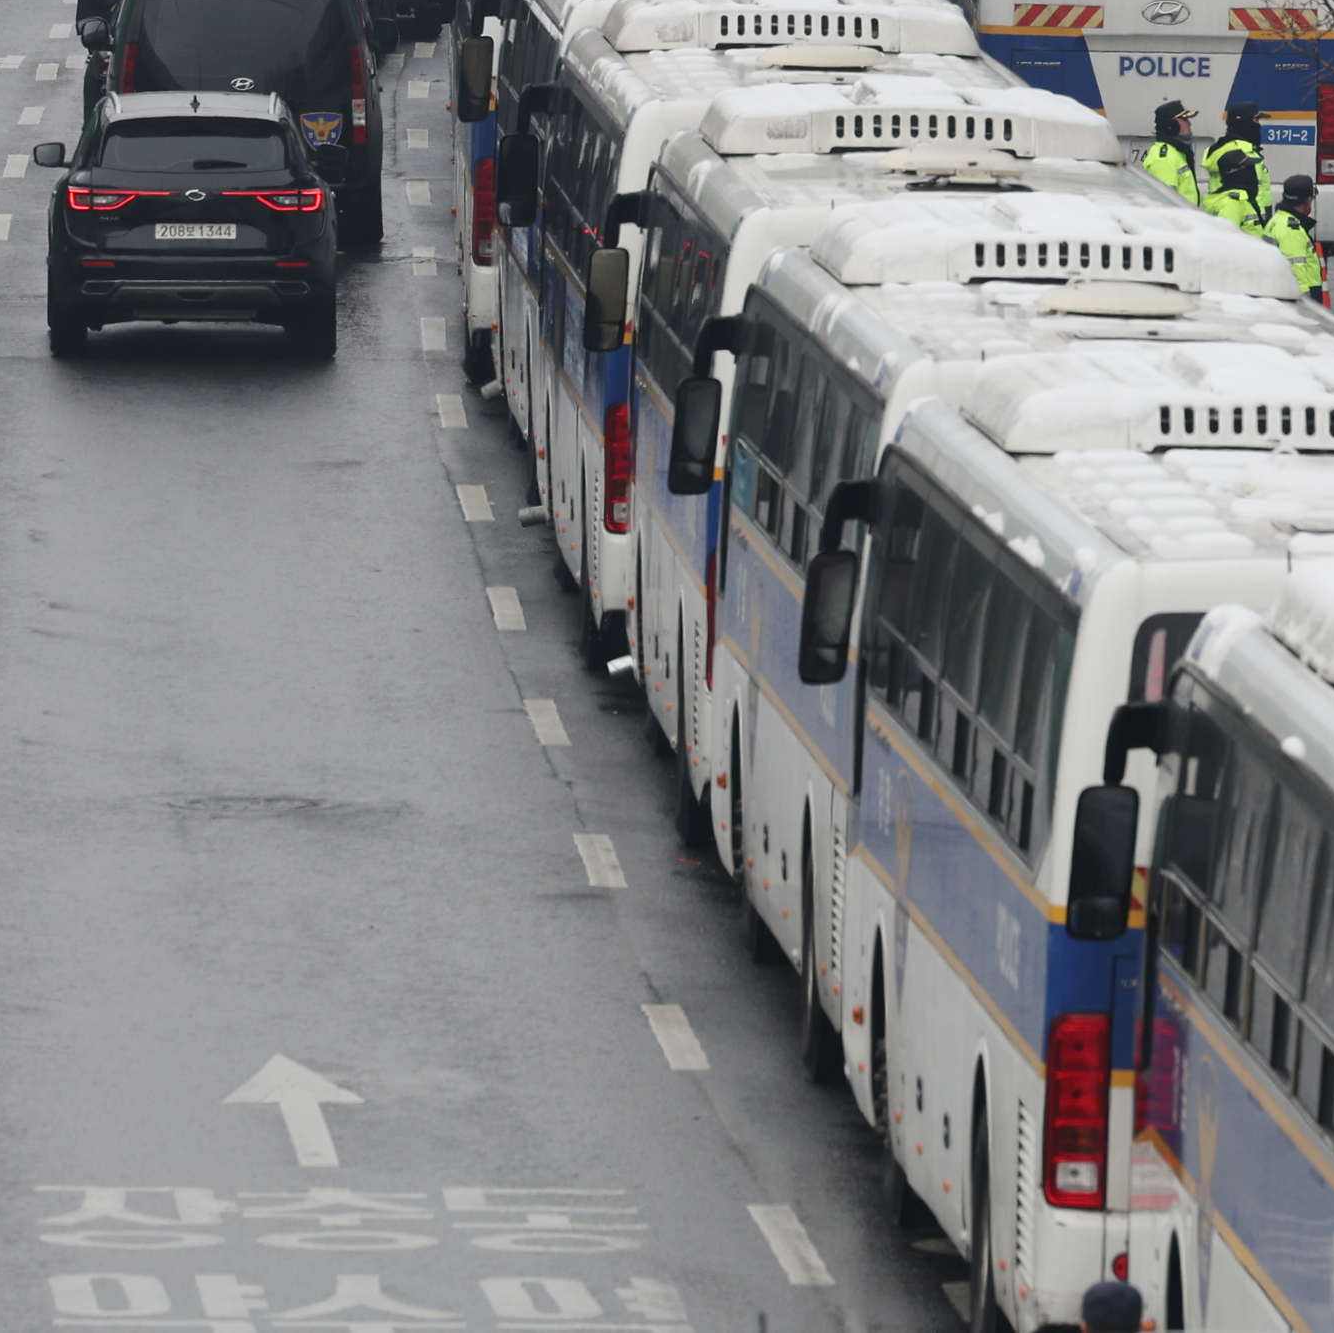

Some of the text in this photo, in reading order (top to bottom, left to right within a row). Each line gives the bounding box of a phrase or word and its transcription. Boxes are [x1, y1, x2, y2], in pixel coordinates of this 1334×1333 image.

[1119, 56, 1211, 78] POLICE
[1267, 128, 1309, 142] 31기-2
[198, 225, 233, 237] 1344
[33, 1186, 648, 1254] 장충동
